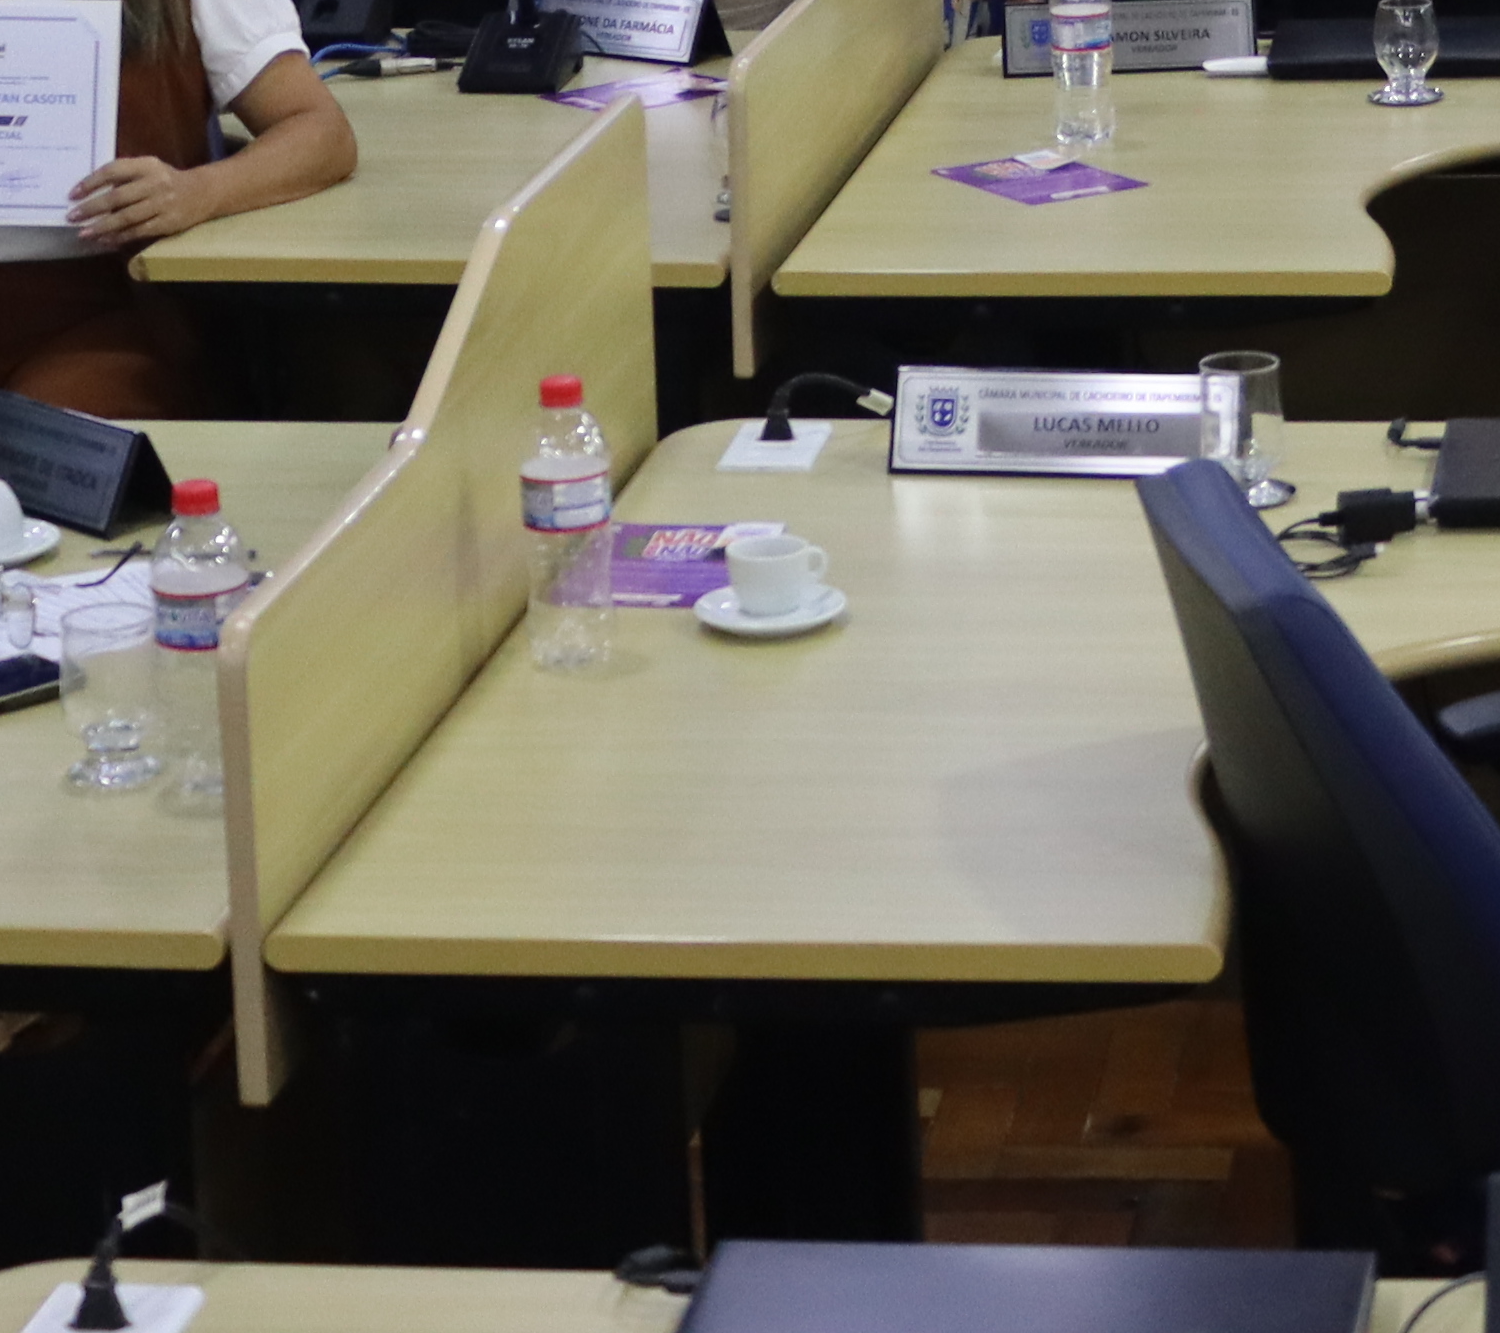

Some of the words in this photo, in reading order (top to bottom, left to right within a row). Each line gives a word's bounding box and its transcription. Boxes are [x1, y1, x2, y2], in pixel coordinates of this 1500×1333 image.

[603, 17, 618, 29] DA
[620, 19, 674, 34] FARMÁCIA
[1154, 28, 1210, 41] SILVEIRA
[1033, 417, 1091, 432] LUCAS
